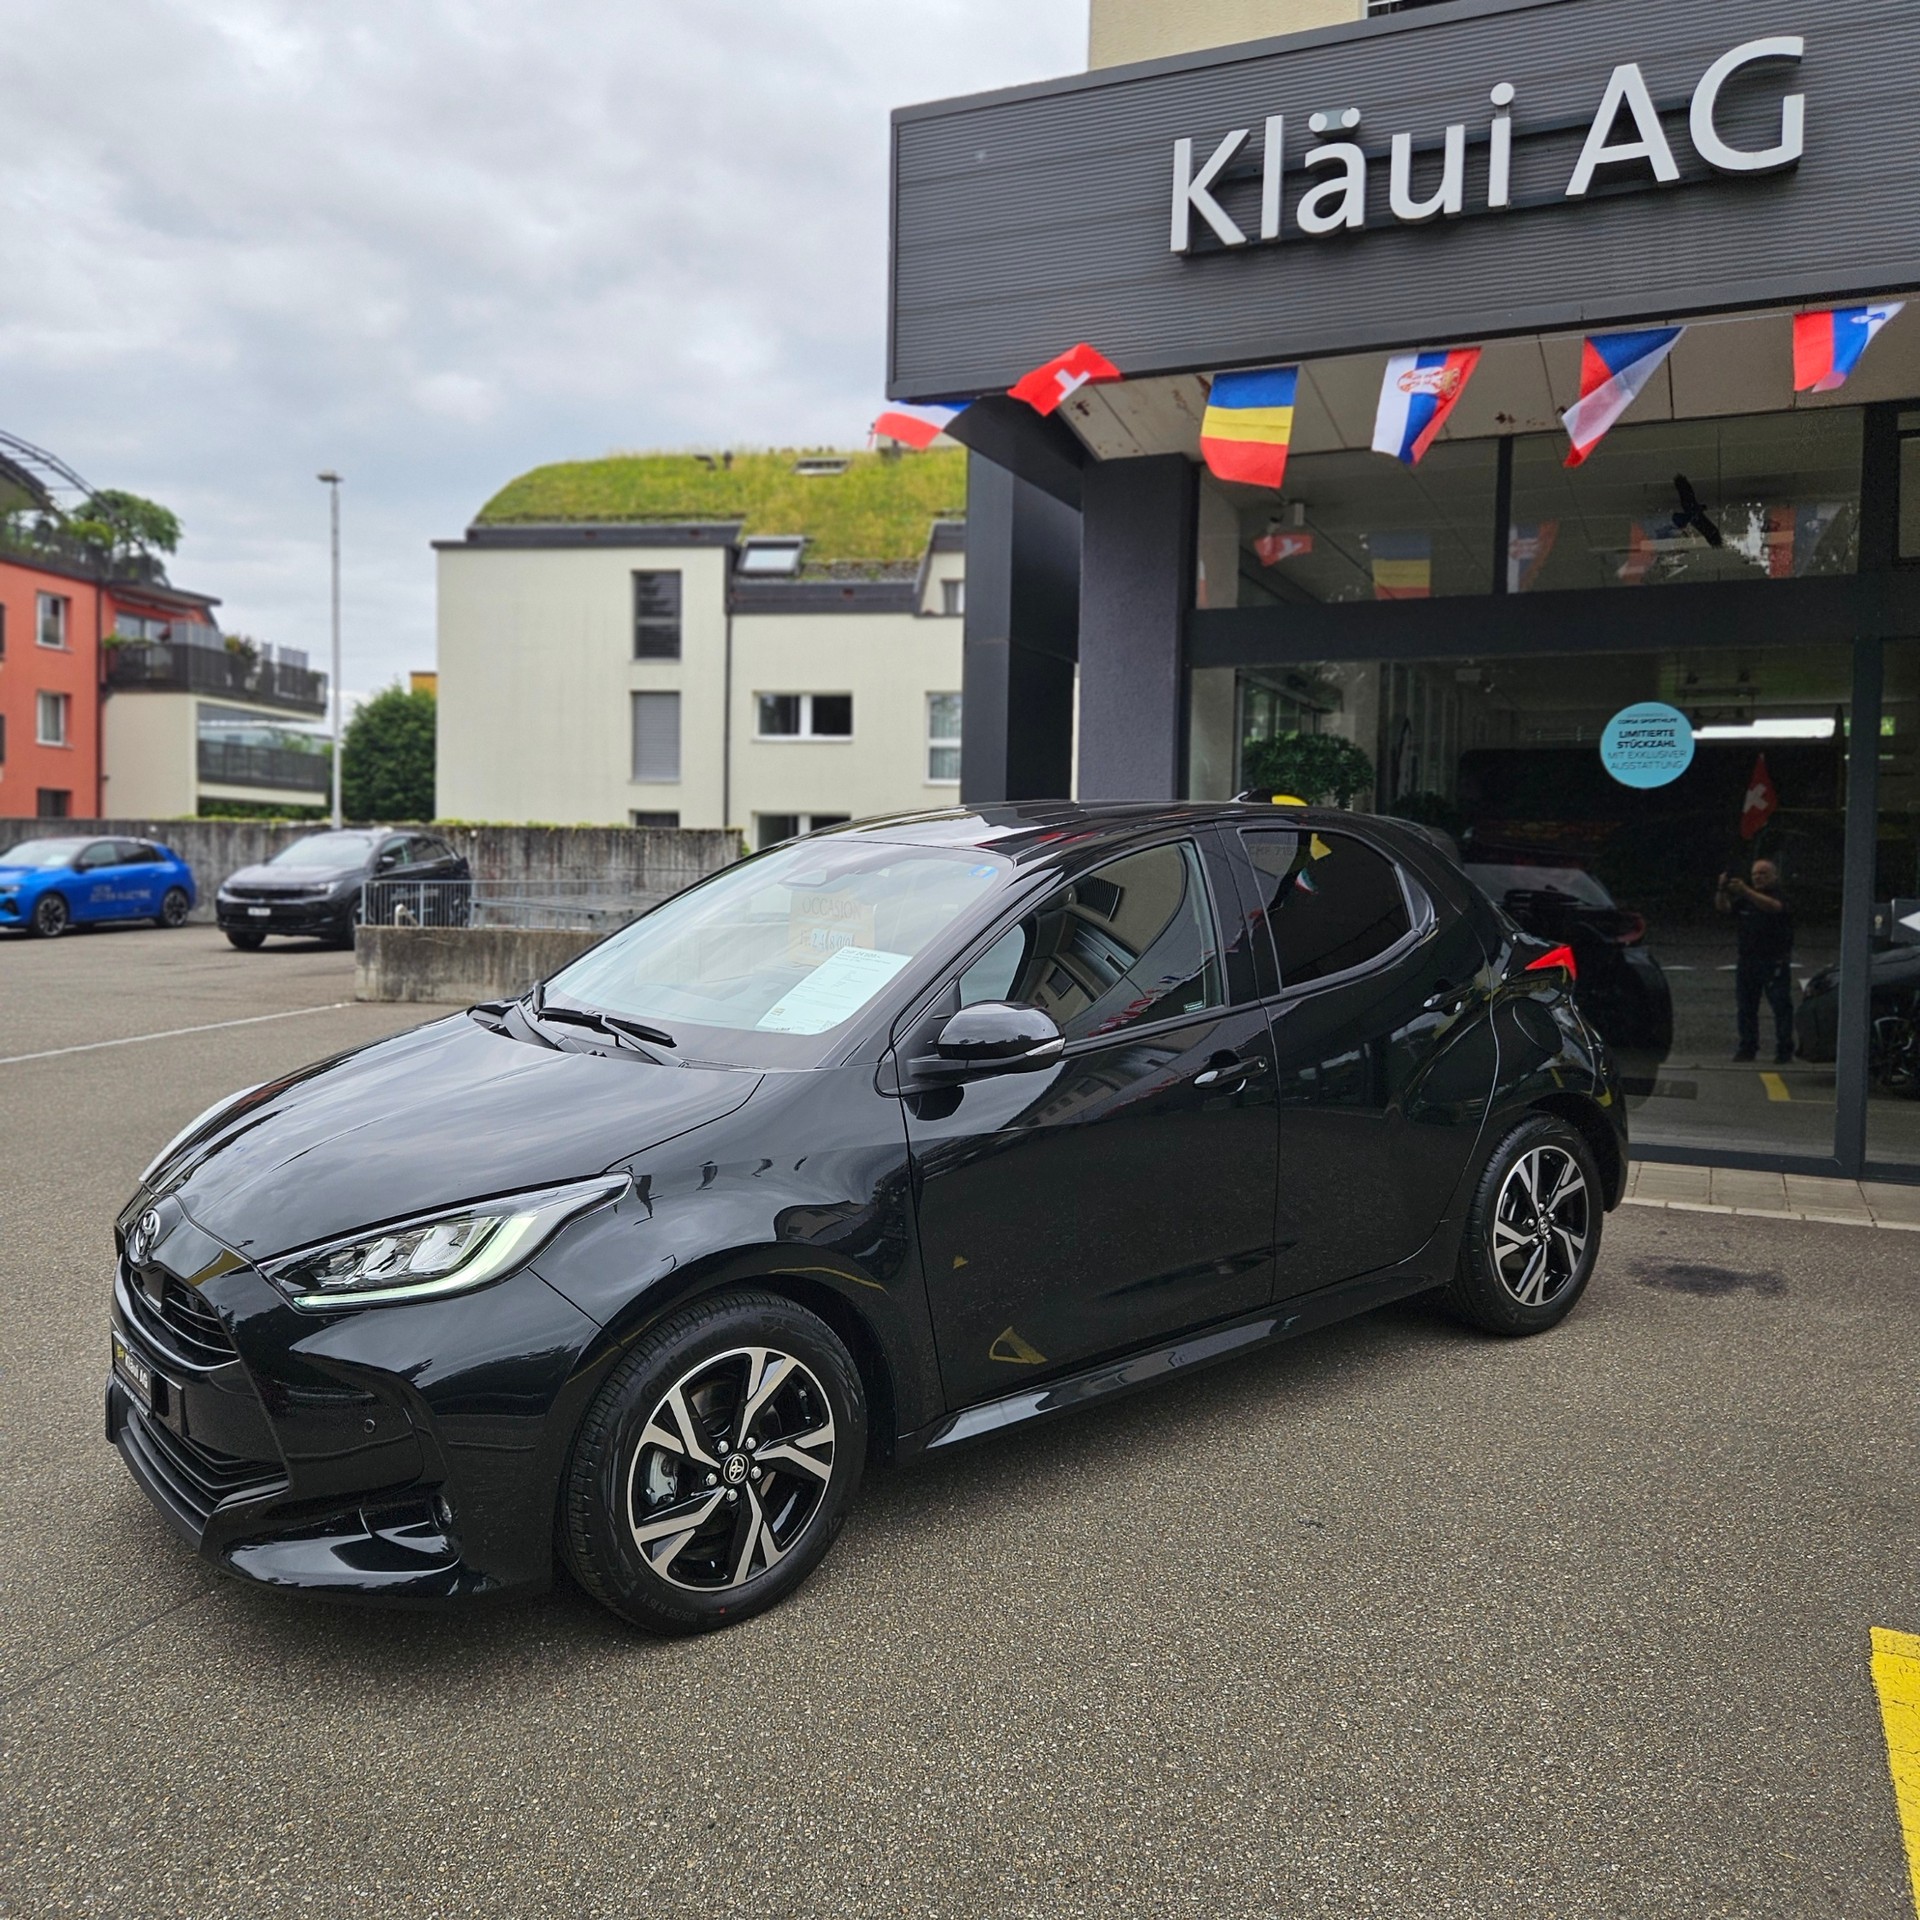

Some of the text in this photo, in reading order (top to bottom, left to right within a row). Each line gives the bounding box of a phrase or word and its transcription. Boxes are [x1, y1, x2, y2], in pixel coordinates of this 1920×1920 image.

[1168, 35, 1805, 255] Kläui AG
[1619, 729, 1676, 738] LIMITIERTE
[1616, 739, 1677, 749] STÜCKZAHL
[1607, 750, 1687, 760] MIT EXKLUSIVER
[1611, 760, 1682, 770] AUSSTATTUNG
[802, 896, 861, 920] OCCASION
[139, 1369, 148, 1389] AG
